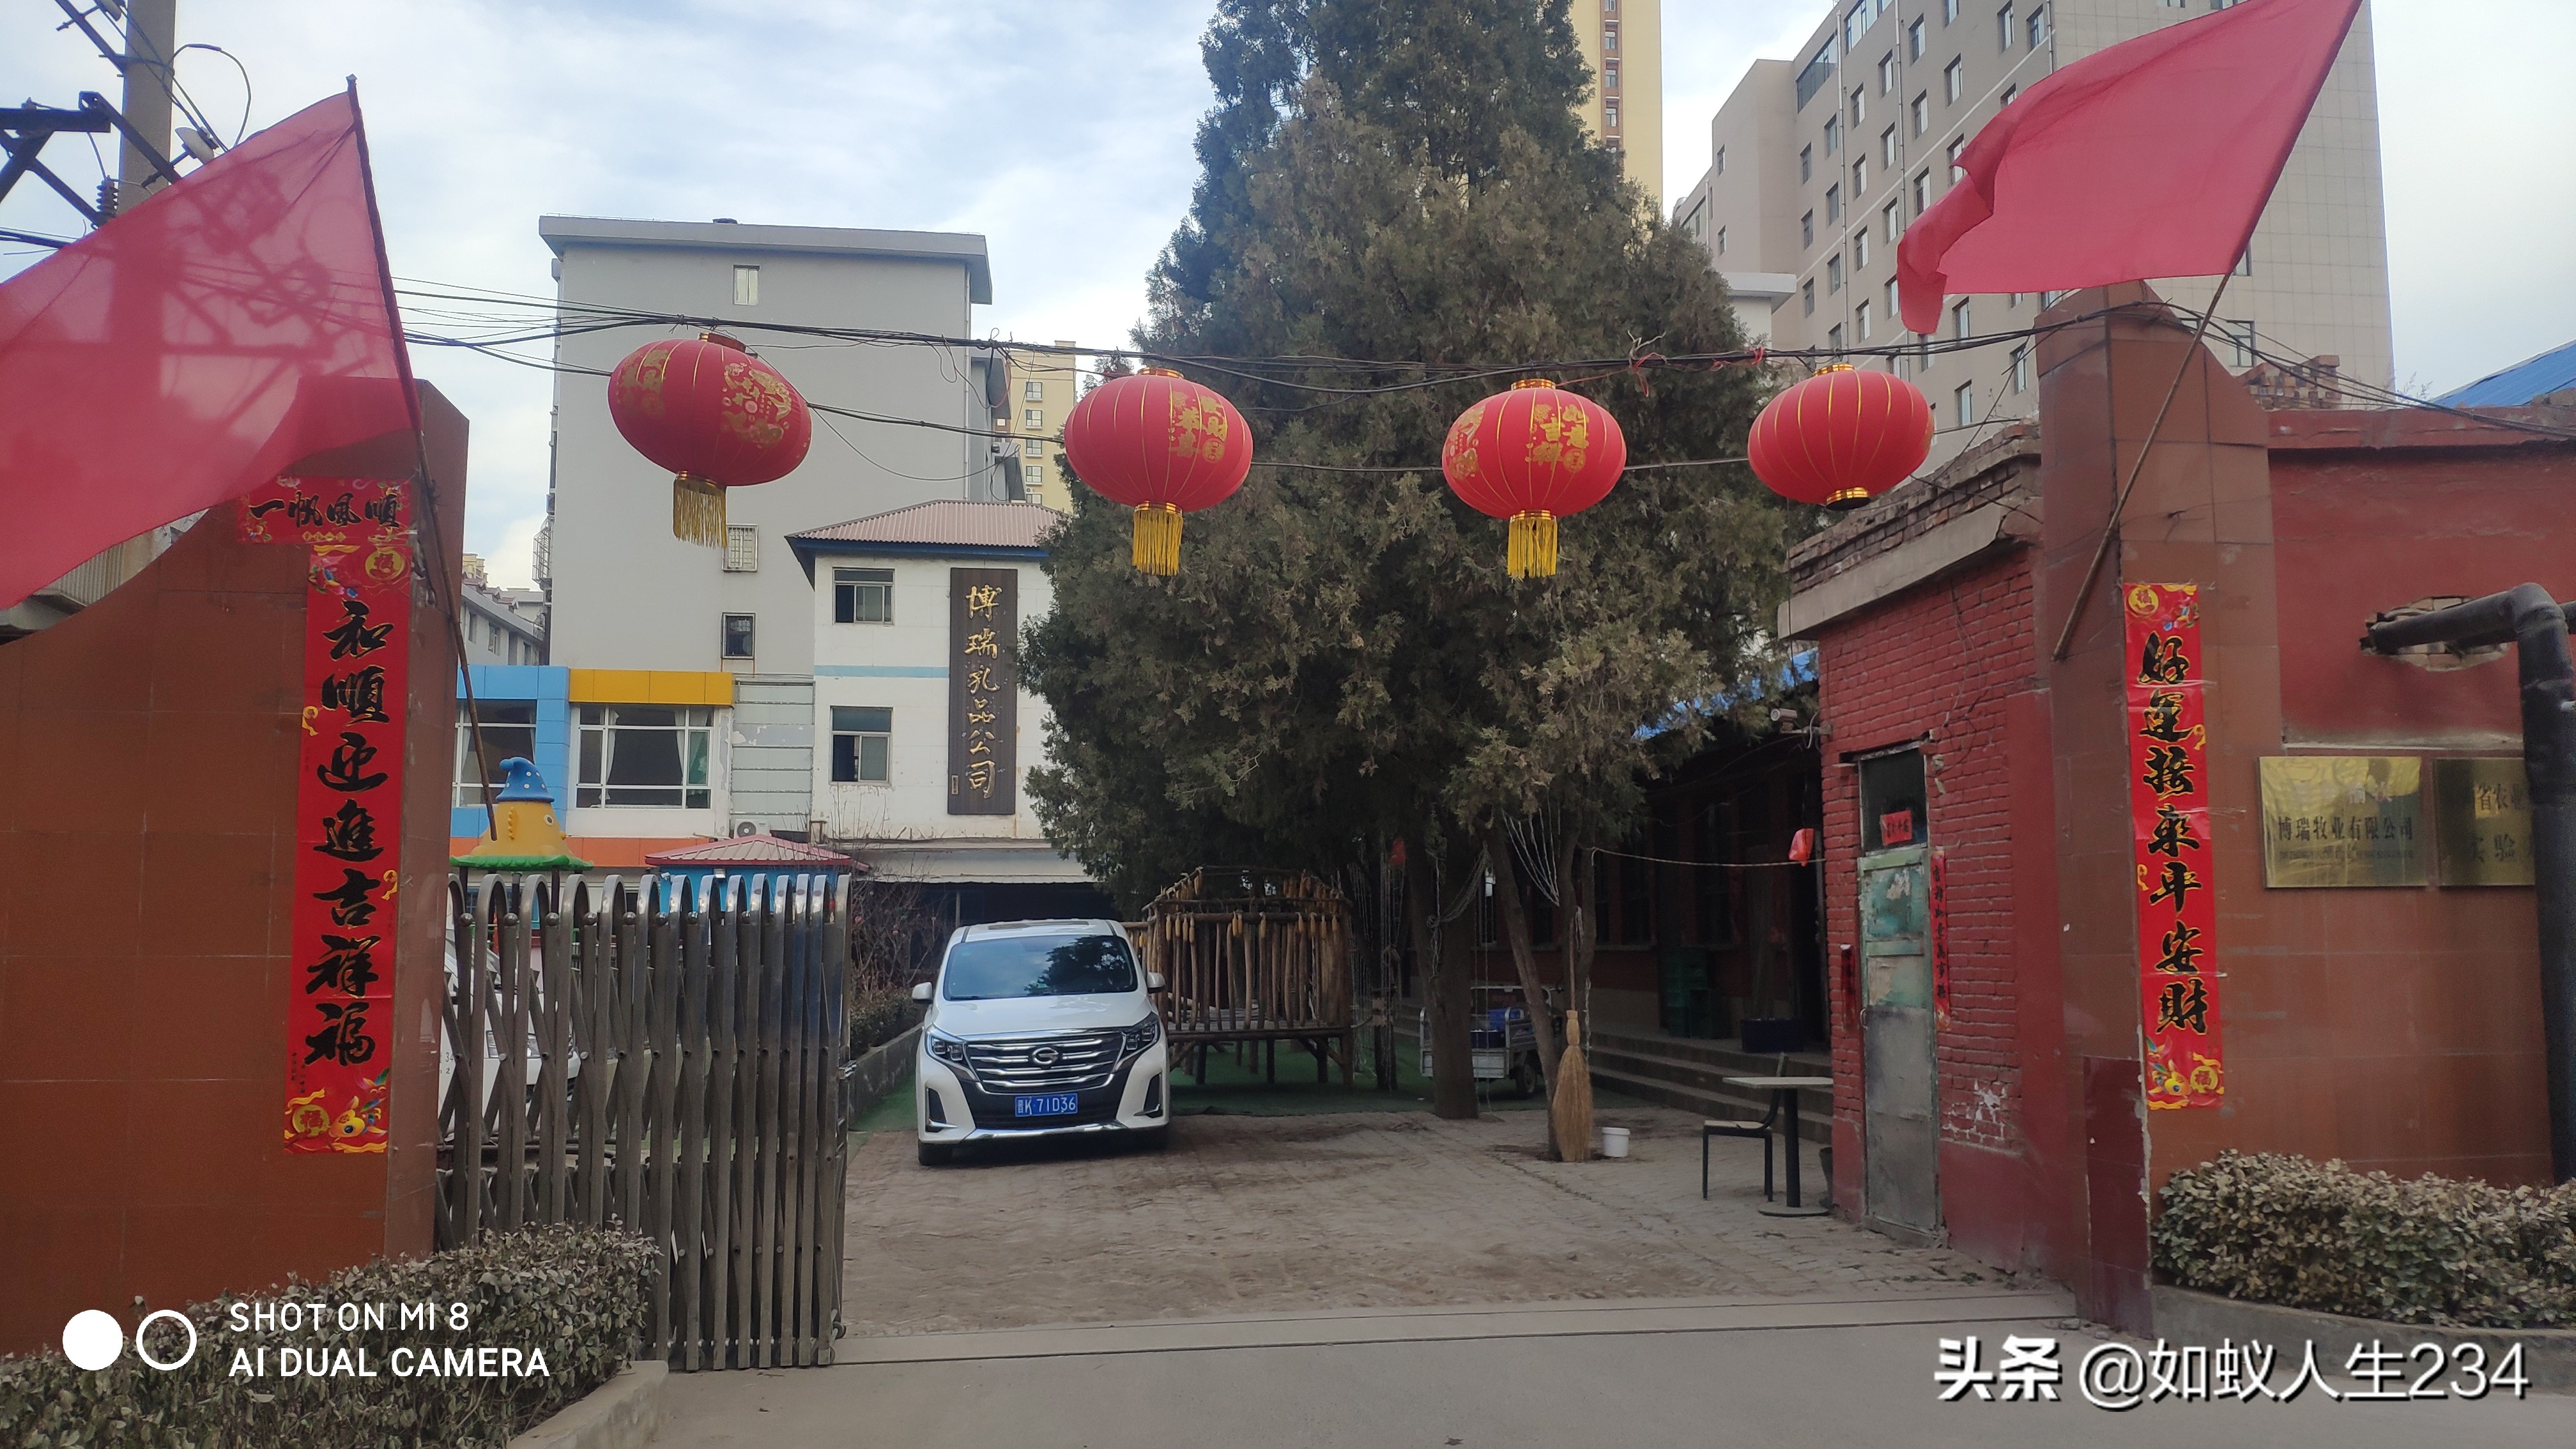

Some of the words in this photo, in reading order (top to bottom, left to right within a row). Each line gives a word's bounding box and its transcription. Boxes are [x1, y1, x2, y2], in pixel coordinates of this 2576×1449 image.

[965, 585, 1003, 799] 博瑞乳品公司
[2278, 815, 2413, 841] 博瑞牧业有限公司
